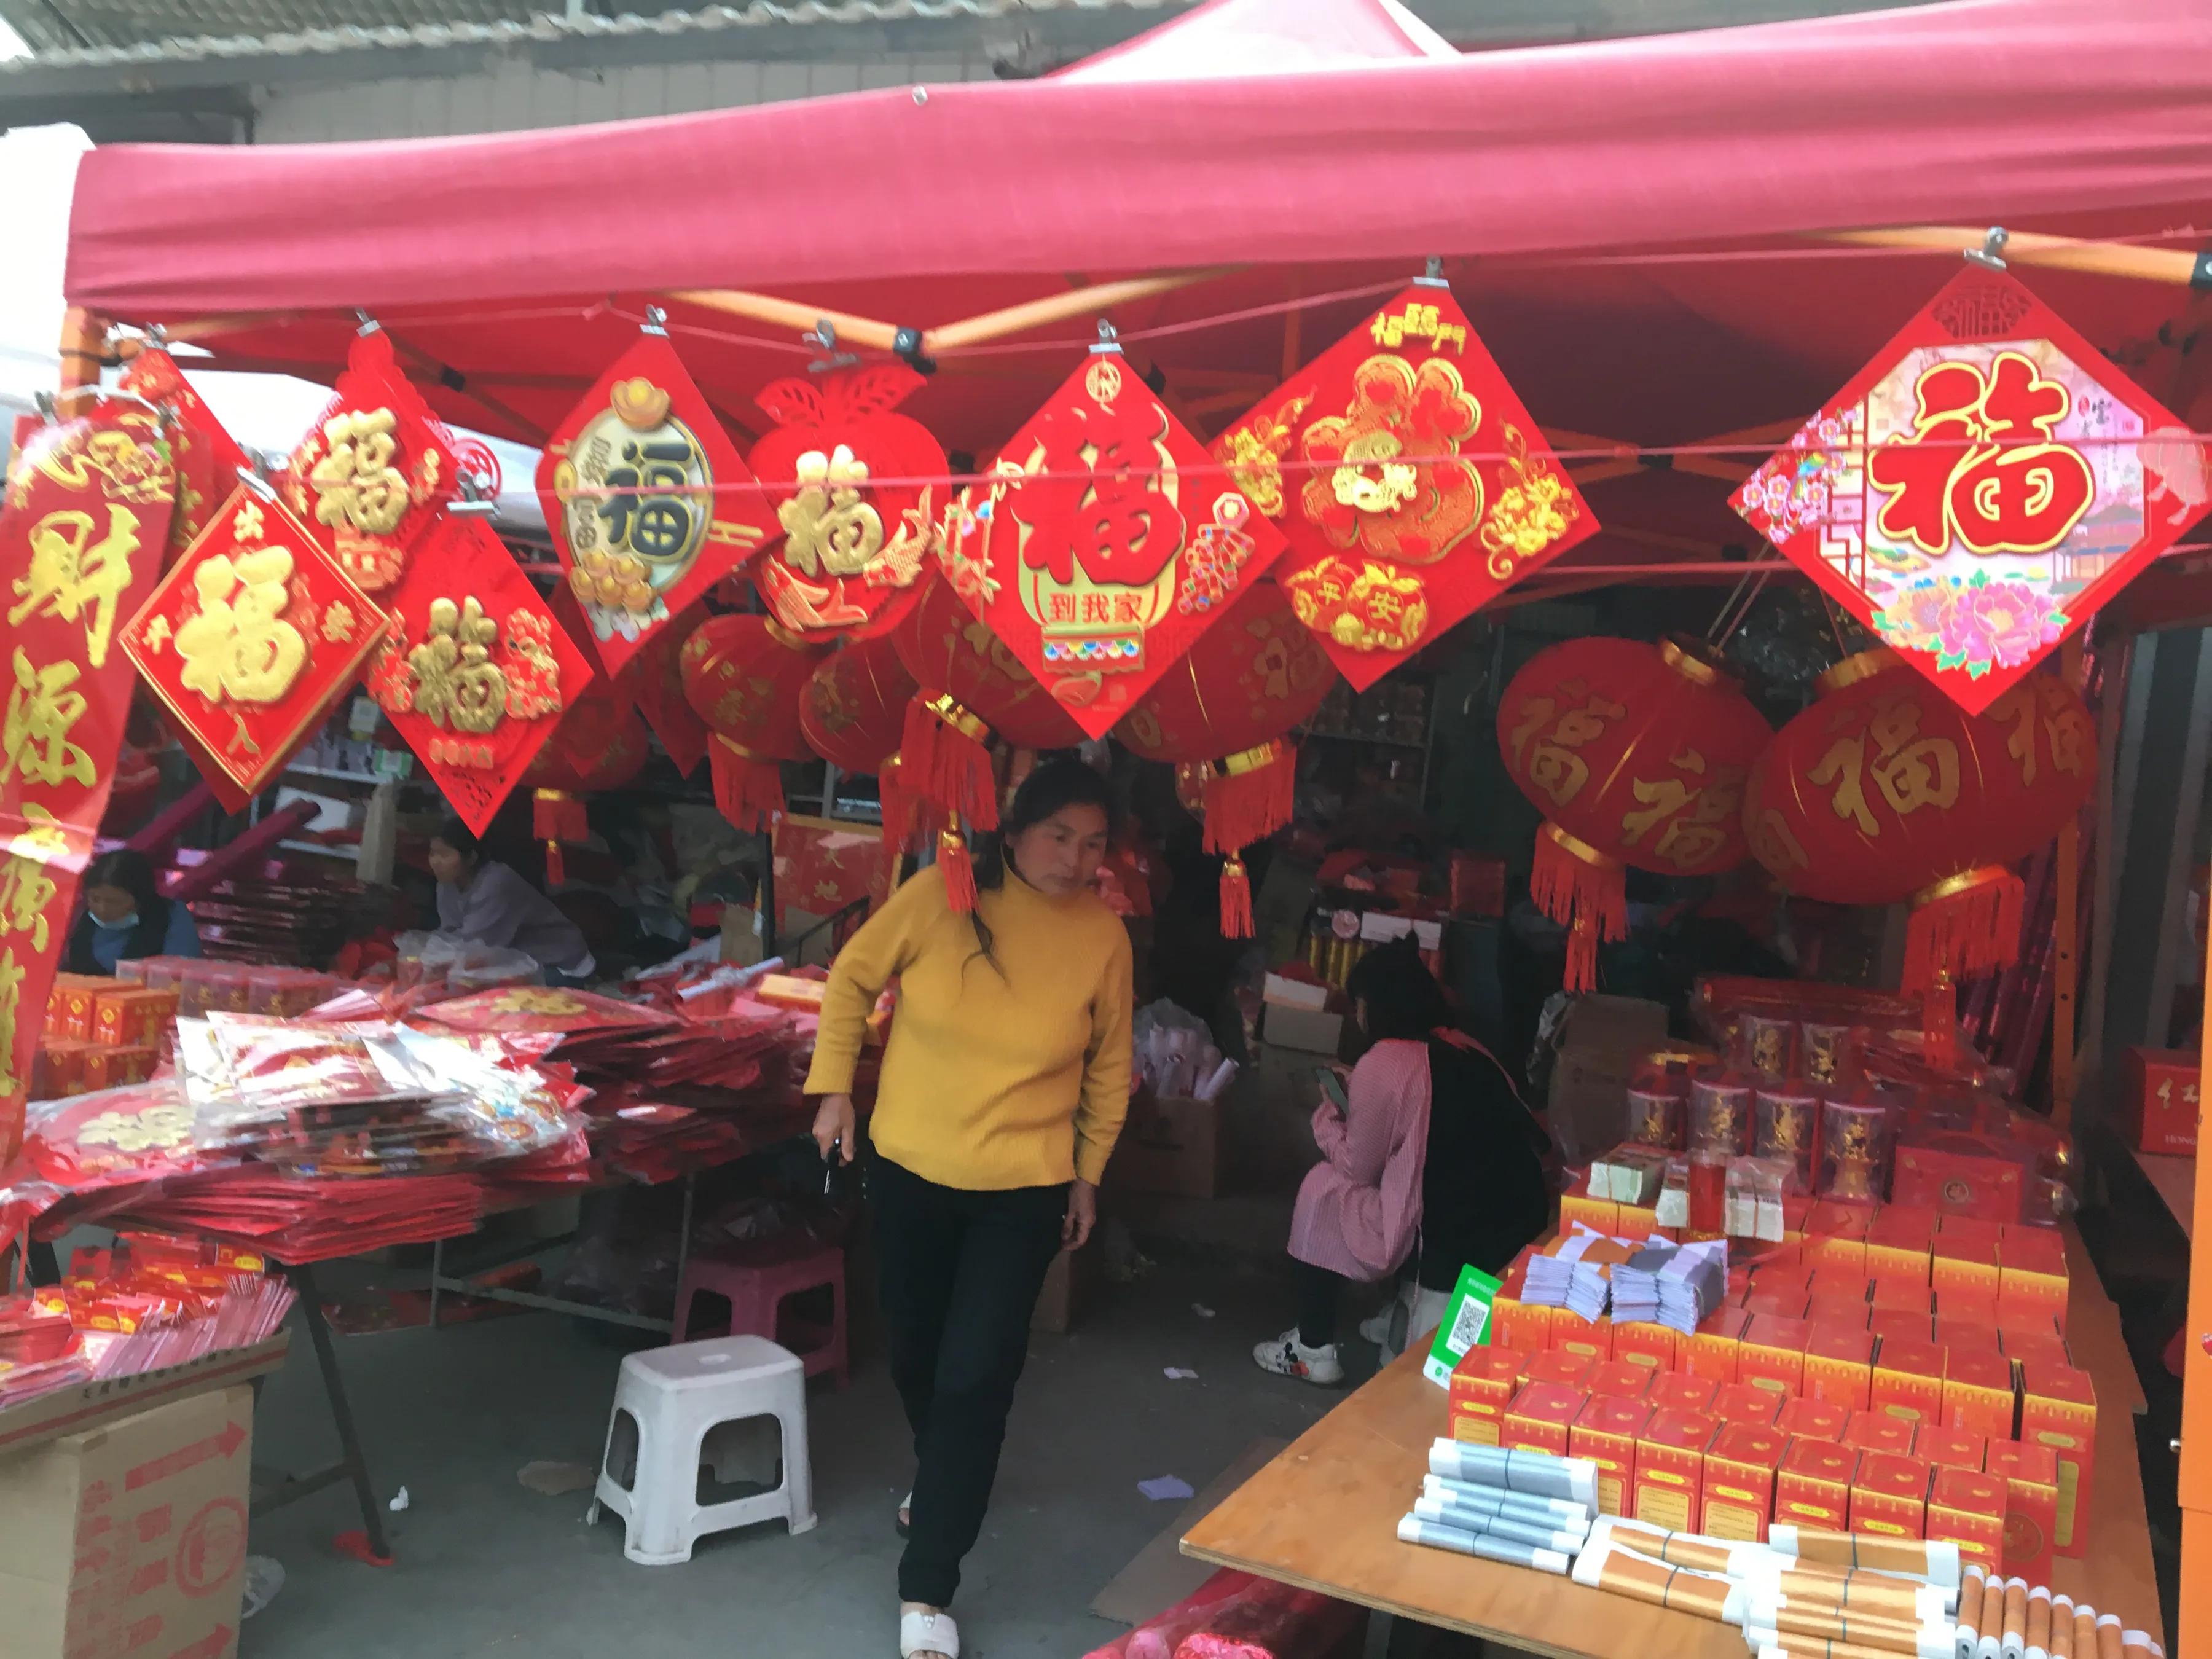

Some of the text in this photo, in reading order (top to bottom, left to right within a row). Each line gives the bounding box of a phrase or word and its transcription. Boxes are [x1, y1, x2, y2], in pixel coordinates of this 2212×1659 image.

[312, 406, 409, 536] 福
[598, 441, 692, 557] 福
[777, 444, 885, 576] 福
[1008, 399, 1186, 587] 福
[1868, 351, 2095, 554] 福
[173, 544, 307, 704] 福
[409, 595, 507, 734] 福
[1048, 592, 1142, 624] 到我家
[1808, 700, 1961, 837] 福
